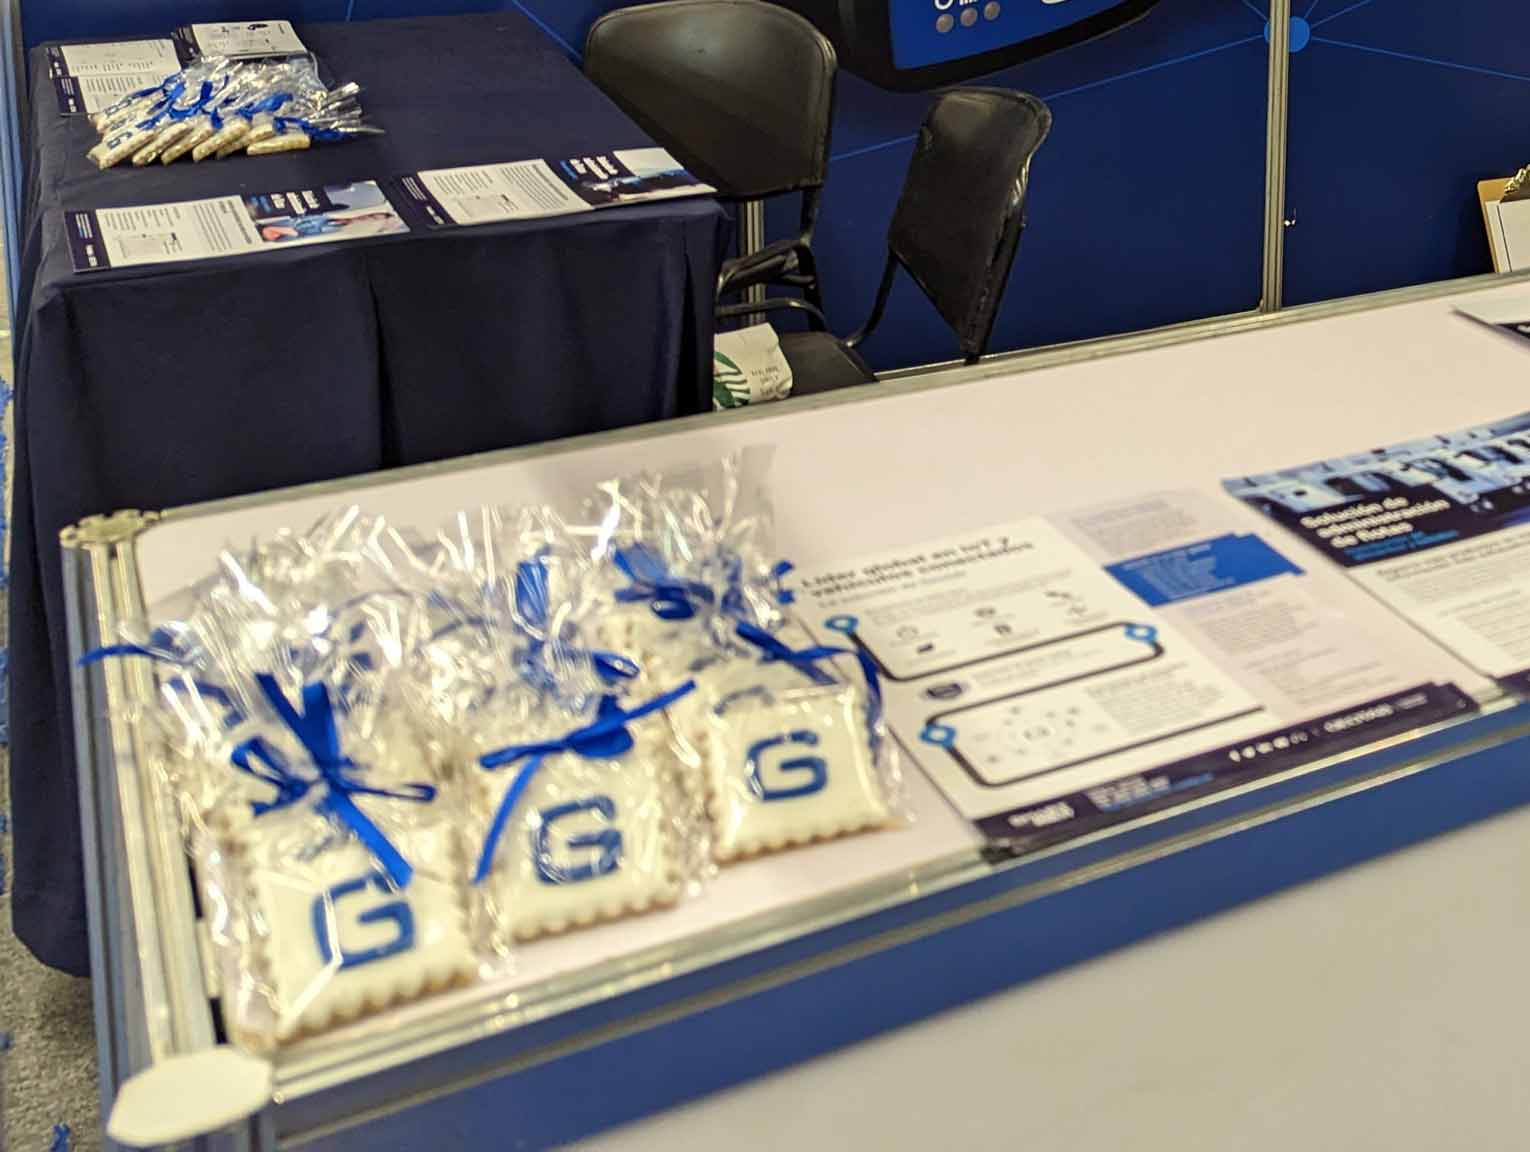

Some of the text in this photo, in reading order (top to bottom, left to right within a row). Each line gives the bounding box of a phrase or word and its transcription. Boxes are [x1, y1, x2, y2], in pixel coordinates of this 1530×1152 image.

[745, 729, 828, 802] G
[531, 793, 623, 886] G
[309, 870, 417, 972] G
